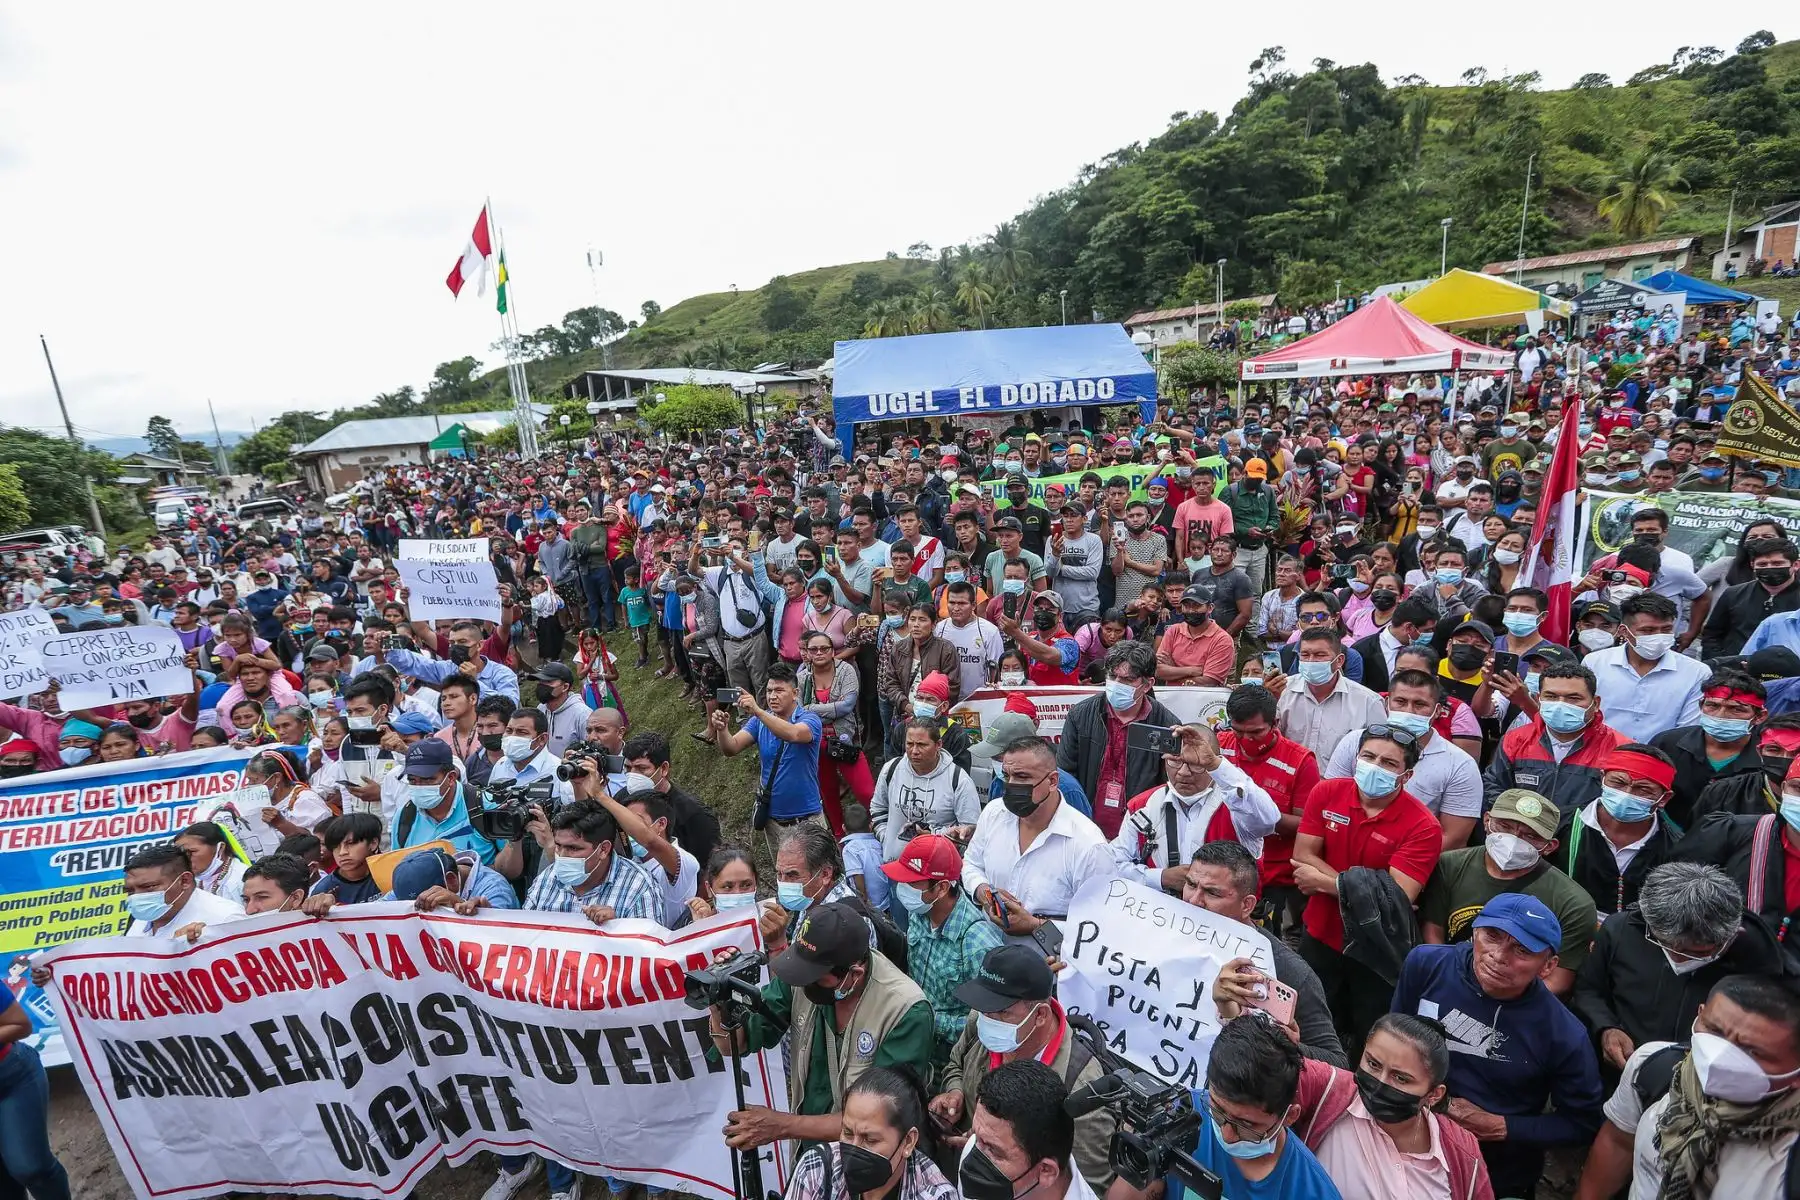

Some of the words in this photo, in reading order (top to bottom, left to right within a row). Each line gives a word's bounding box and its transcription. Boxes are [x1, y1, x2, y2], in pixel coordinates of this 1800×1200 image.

[868, 390, 939, 416] UGEL
[959, 386, 990, 409] EL
[1001, 378, 1115, 406] DORADO
[1762, 425, 1787, 441] SEDE
[1676, 502, 1743, 518] ASOCIACIÓN
[1744, 510, 1758, 520] DE
[1672, 516, 1701, 528] PERÚ
[429, 543, 477, 554] PRESIDENTE
[417, 569, 479, 585] CASTILLO
[446, 585, 456, 594] EL
[423, 595, 453, 606] PUEBLO
[16, 615, 48, 628] DEL
[43, 635, 109, 657] CIERRE
[111, 630, 139, 650] DEL
[83, 642, 157, 666] CONGRESO
[166, 644, 177, 658] Y
[52, 669, 102, 685] NUEVA
[84, 788, 116, 811] DE
[48, 903, 114, 923] Poblado
[34, 921, 112, 945] Provincia
[1105, 879, 1268, 970] PRESIDENTE
[63, 974, 114, 1020] POR
[116, 971, 145, 1021] LA
[141, 937, 347, 1018] DEMOCRACIA
[369, 932, 421, 981] LA
[419, 928, 742, 1011] GOBERNABILID
[1072, 920, 1162, 992] PISTA
[1176, 978, 1205, 1010] Y
[98, 1014, 335, 1100] ASAMBLEA
[320, 990, 751, 1090] CONSTITUYENT
